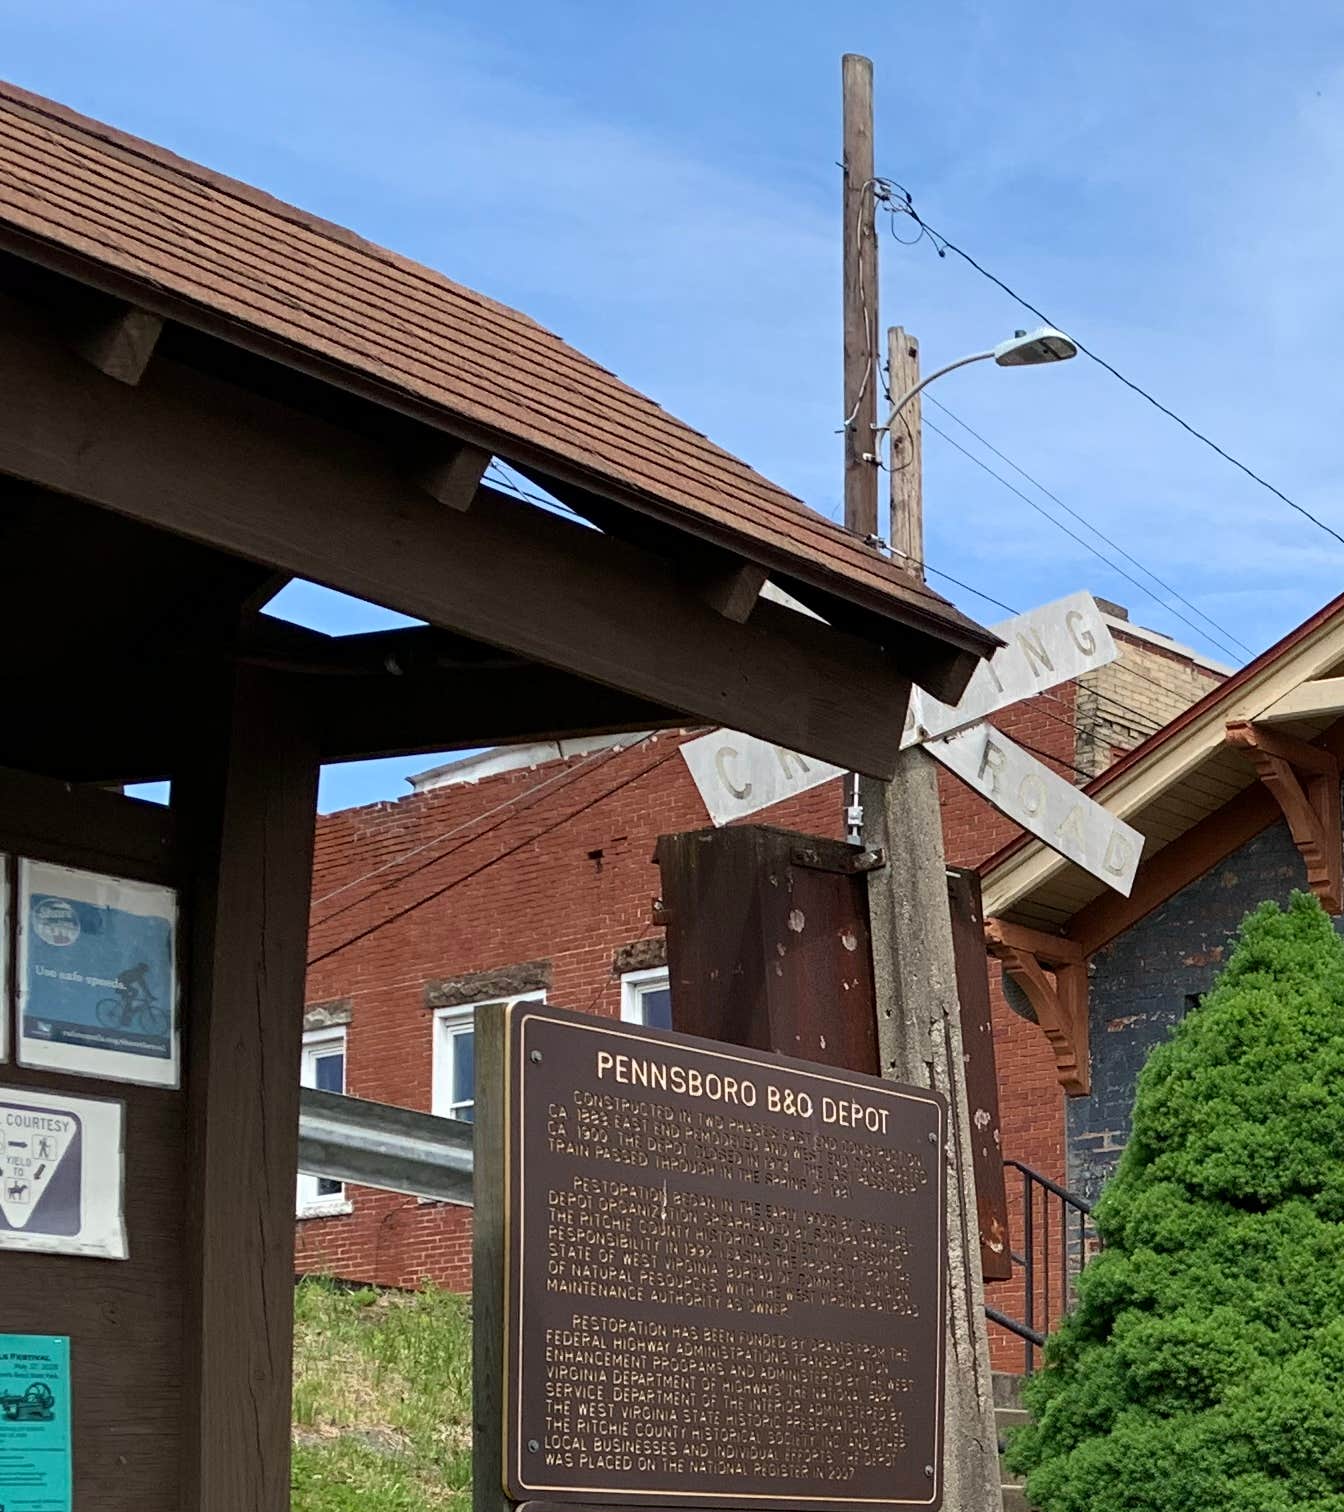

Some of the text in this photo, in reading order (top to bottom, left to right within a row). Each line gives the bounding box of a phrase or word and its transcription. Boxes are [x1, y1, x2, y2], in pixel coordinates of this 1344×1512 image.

[977, 738, 1134, 878] ROAD
[573, 1088, 674, 1122] CONSTRUCTED
[678, 1108, 691, 1125] IN
[596, 1049, 890, 1135] PENNSBORO B&O DEPOT
[6, 1113, 70, 1132] COURTESY
[613, 1114, 647, 1135] EAST
[653, 1121, 679, 1141] END
[618, 1132, 640, 1150] THE
[647, 1137, 687, 1158] DEPOT
[7, 1156, 32, 1168] YIELD
[13, 1167, 24, 1177] TO
[547, 1137, 760, 1186] TRAIN PASSED THROUGH IN THE
[547, 1189, 593, 1211] DEPOT
[599, 1197, 696, 1226] ORGANIZATION
[573, 1175, 667, 1204] RESTORATION
[673, 1190, 716, 1211] BEGAN
[719, 1198, 732, 1214] IN
[738, 1200, 760, 1218] THE
[548, 1207, 764, 1252] THE RITCHIE COUNTY HISTORICAL
[548, 1224, 659, 1253] RESPONSIBILITY
[665, 1240, 677, 1255] IN
[548, 1242, 591, 1261] STATE
[598, 1248, 616, 1265] OF
[622, 1252, 656, 1270] WEST
[664, 1257, 717, 1277] VIRGINIA
[548, 1259, 565, 1276] OF
[571, 1262, 632, 1284] NATURAL
[546, 1276, 643, 1302] MAINTENANCE
[650, 1288, 720, 1311] AUTHORITY
[726, 1297, 742, 1313] AS
[545, 1328, 607, 1349] FEDERAL
[613, 1334, 669, 1355] HIGHWAY
[571, 1313, 666, 1338] RESTORATION
[671, 1323, 698, 1341] HAS
[703, 1327, 734, 1345] BEEN
[545, 1346, 646, 1370] ENHANCEMENT
[652, 1356, 725, 1377] PROGRAMS
[729, 1363, 754, 1379] AND
[545, 1363, 607, 1383] VIRGINIA
[612, 1369, 695, 1391] DEPARTMENT
[702, 1377, 716, 1392] OF
[545, 1381, 603, 1401] SERVICE
[612, 1386, 695, 1407] DEPARTMENT
[702, 1393, 717, 1409] OF
[722, 1395, 744, 1411] THE
[545, 1398, 780, 1430] THE WEST VIRGINIA STATE HISTORIC
[544, 1416, 761, 1445] THE RITCHIE COUNTY HISTORICAL
[543, 1433, 778, 1462] LOCAL BUSINESSES AND INDIVIDUAL
[544, 1451, 574, 1468] WAS
[579, 1453, 632, 1471] PLACED
[638, 1456, 656, 1472] ON
[661, 1457, 684, 1473] THE
[689, 1459, 748, 1476] NATIONAL
[753, 1462, 809, 1479] REGISTER
